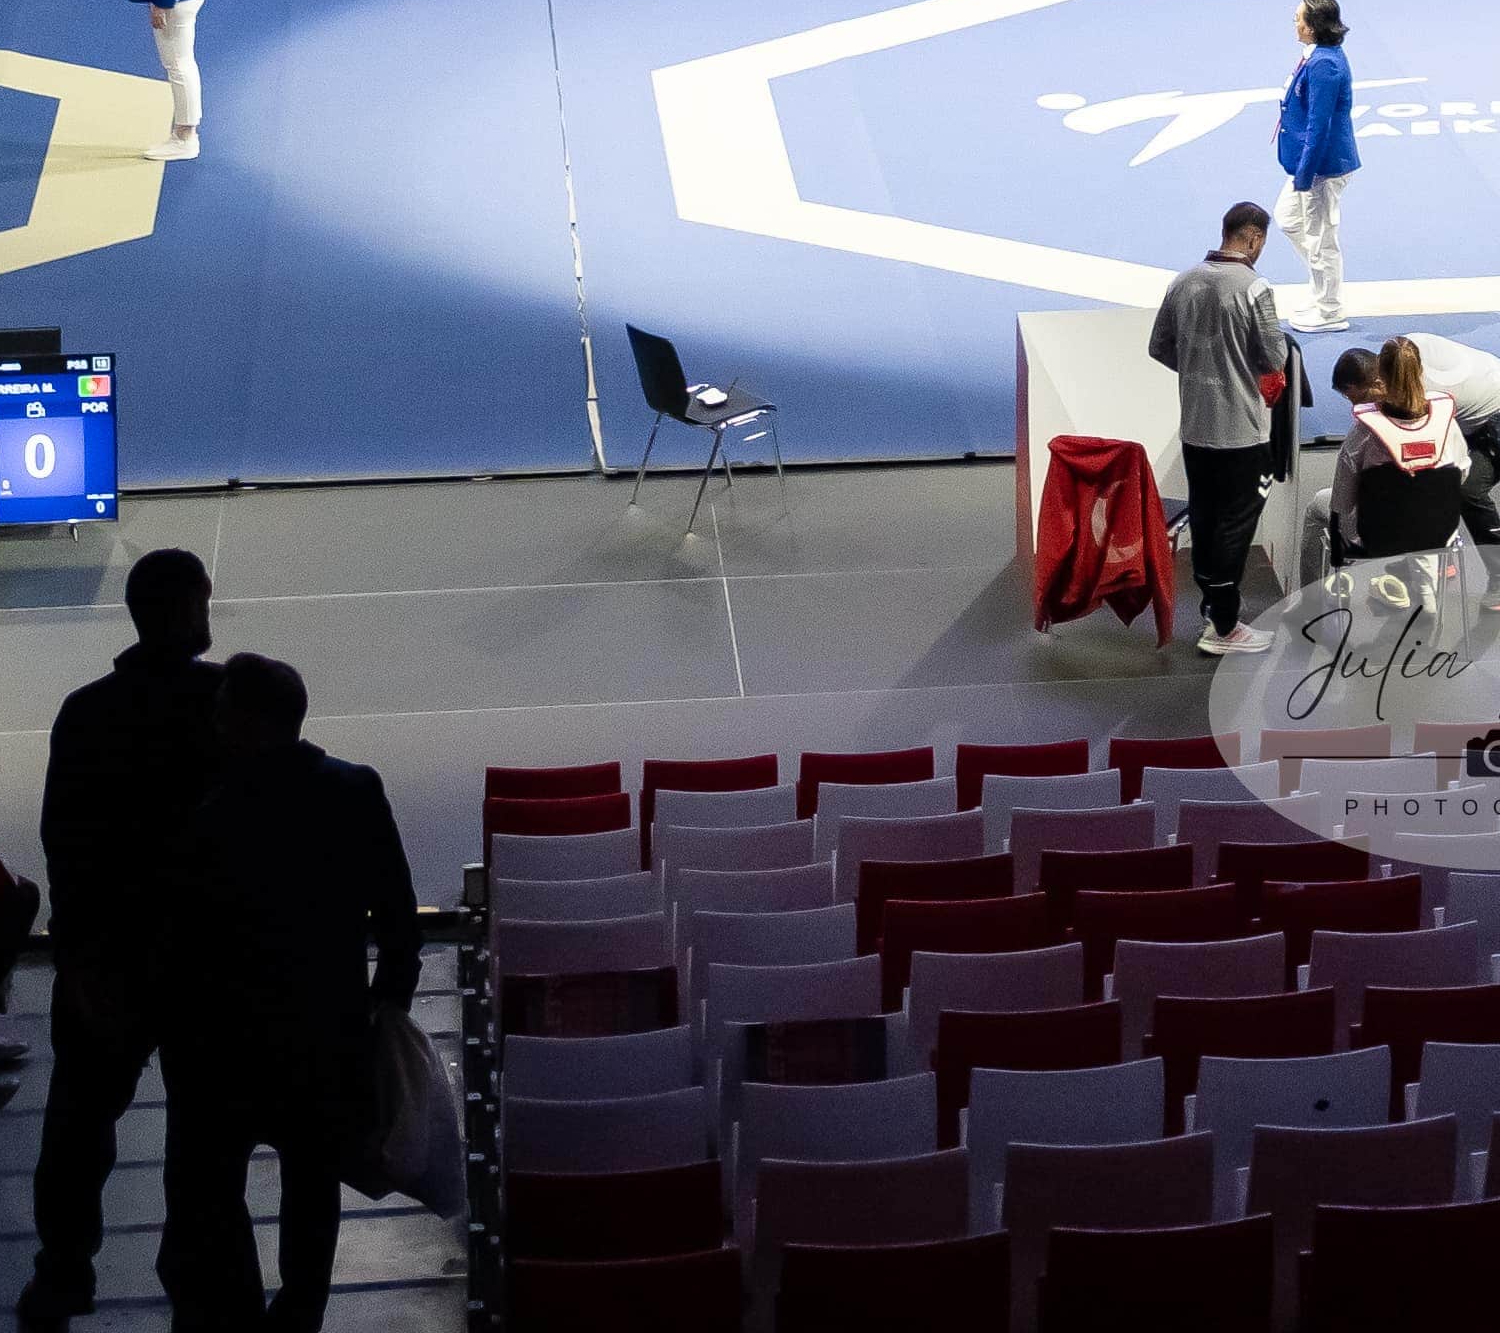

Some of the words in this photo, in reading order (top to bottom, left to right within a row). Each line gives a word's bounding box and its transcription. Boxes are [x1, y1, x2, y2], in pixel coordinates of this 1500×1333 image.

[82, 402, 109, 414] POR
[24, 434, 56, 479] 0
[95, 500, 106, 514] 0
